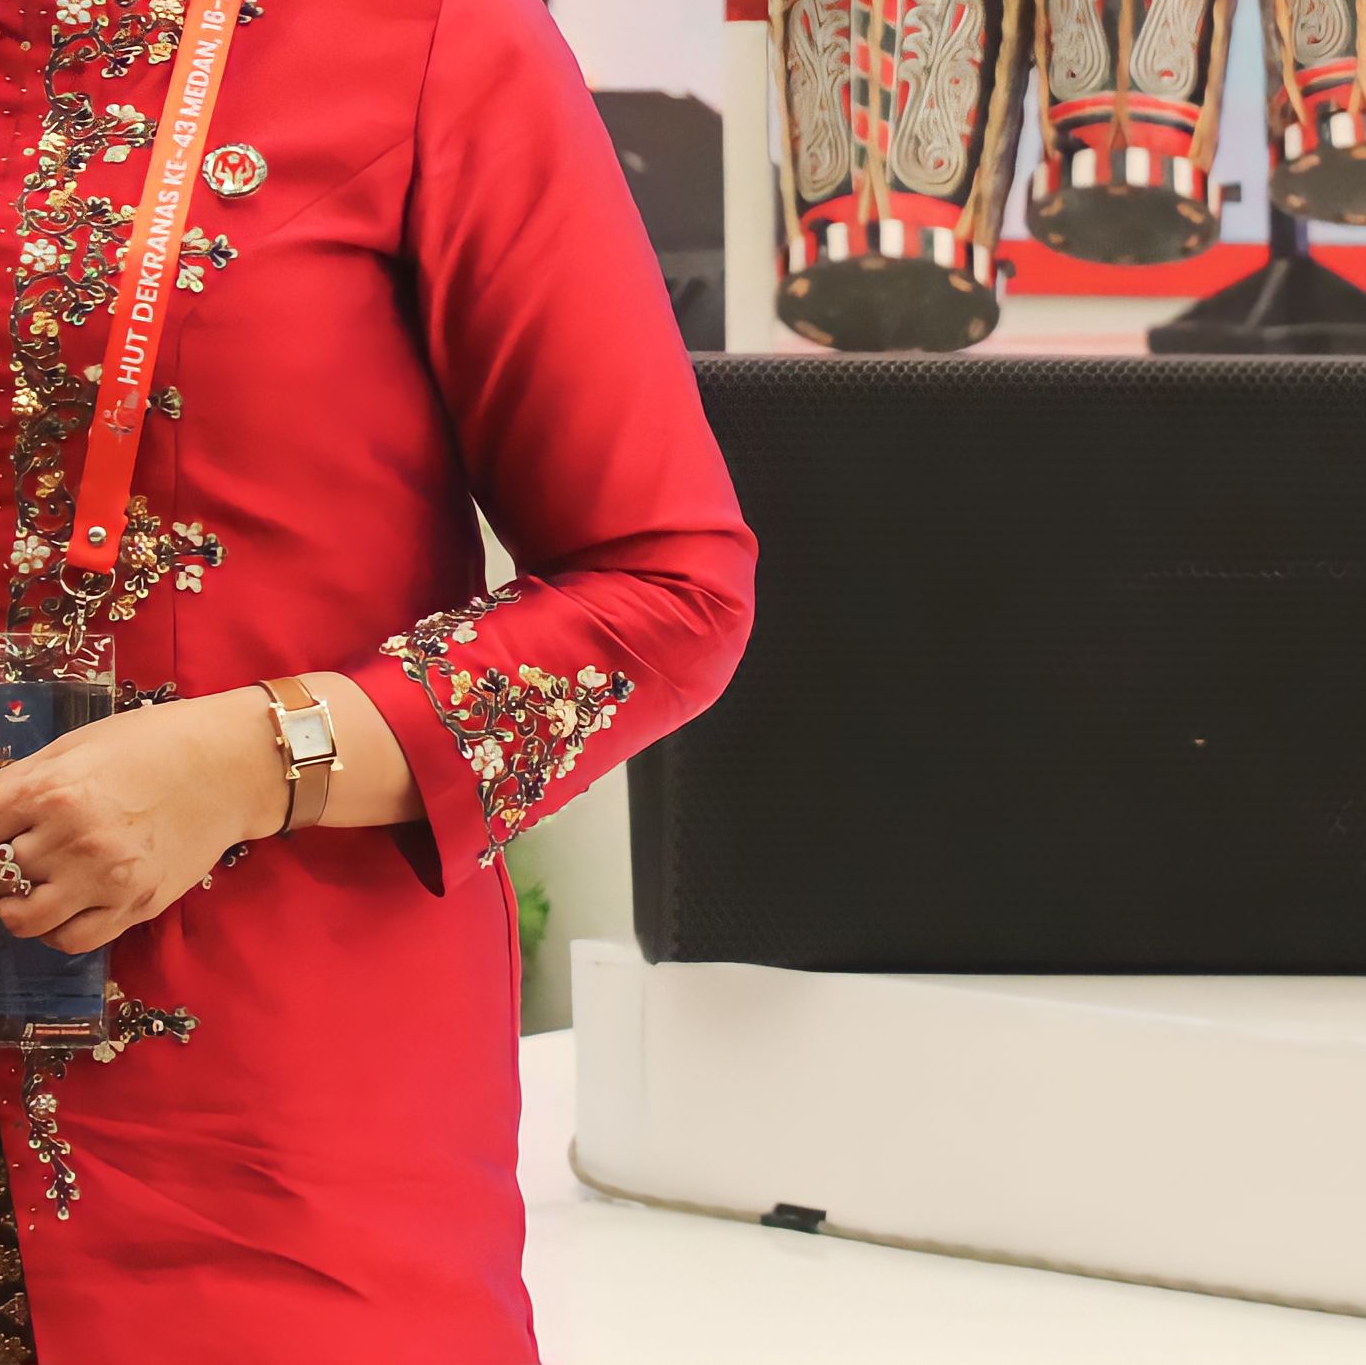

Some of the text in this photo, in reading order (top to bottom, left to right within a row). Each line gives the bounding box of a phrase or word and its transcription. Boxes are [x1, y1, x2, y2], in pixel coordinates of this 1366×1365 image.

[179, 39, 222, 117] MEDAN,
[132, 190, 180, 323] DEKRANAS
[117, 327, 148, 385] HUT
